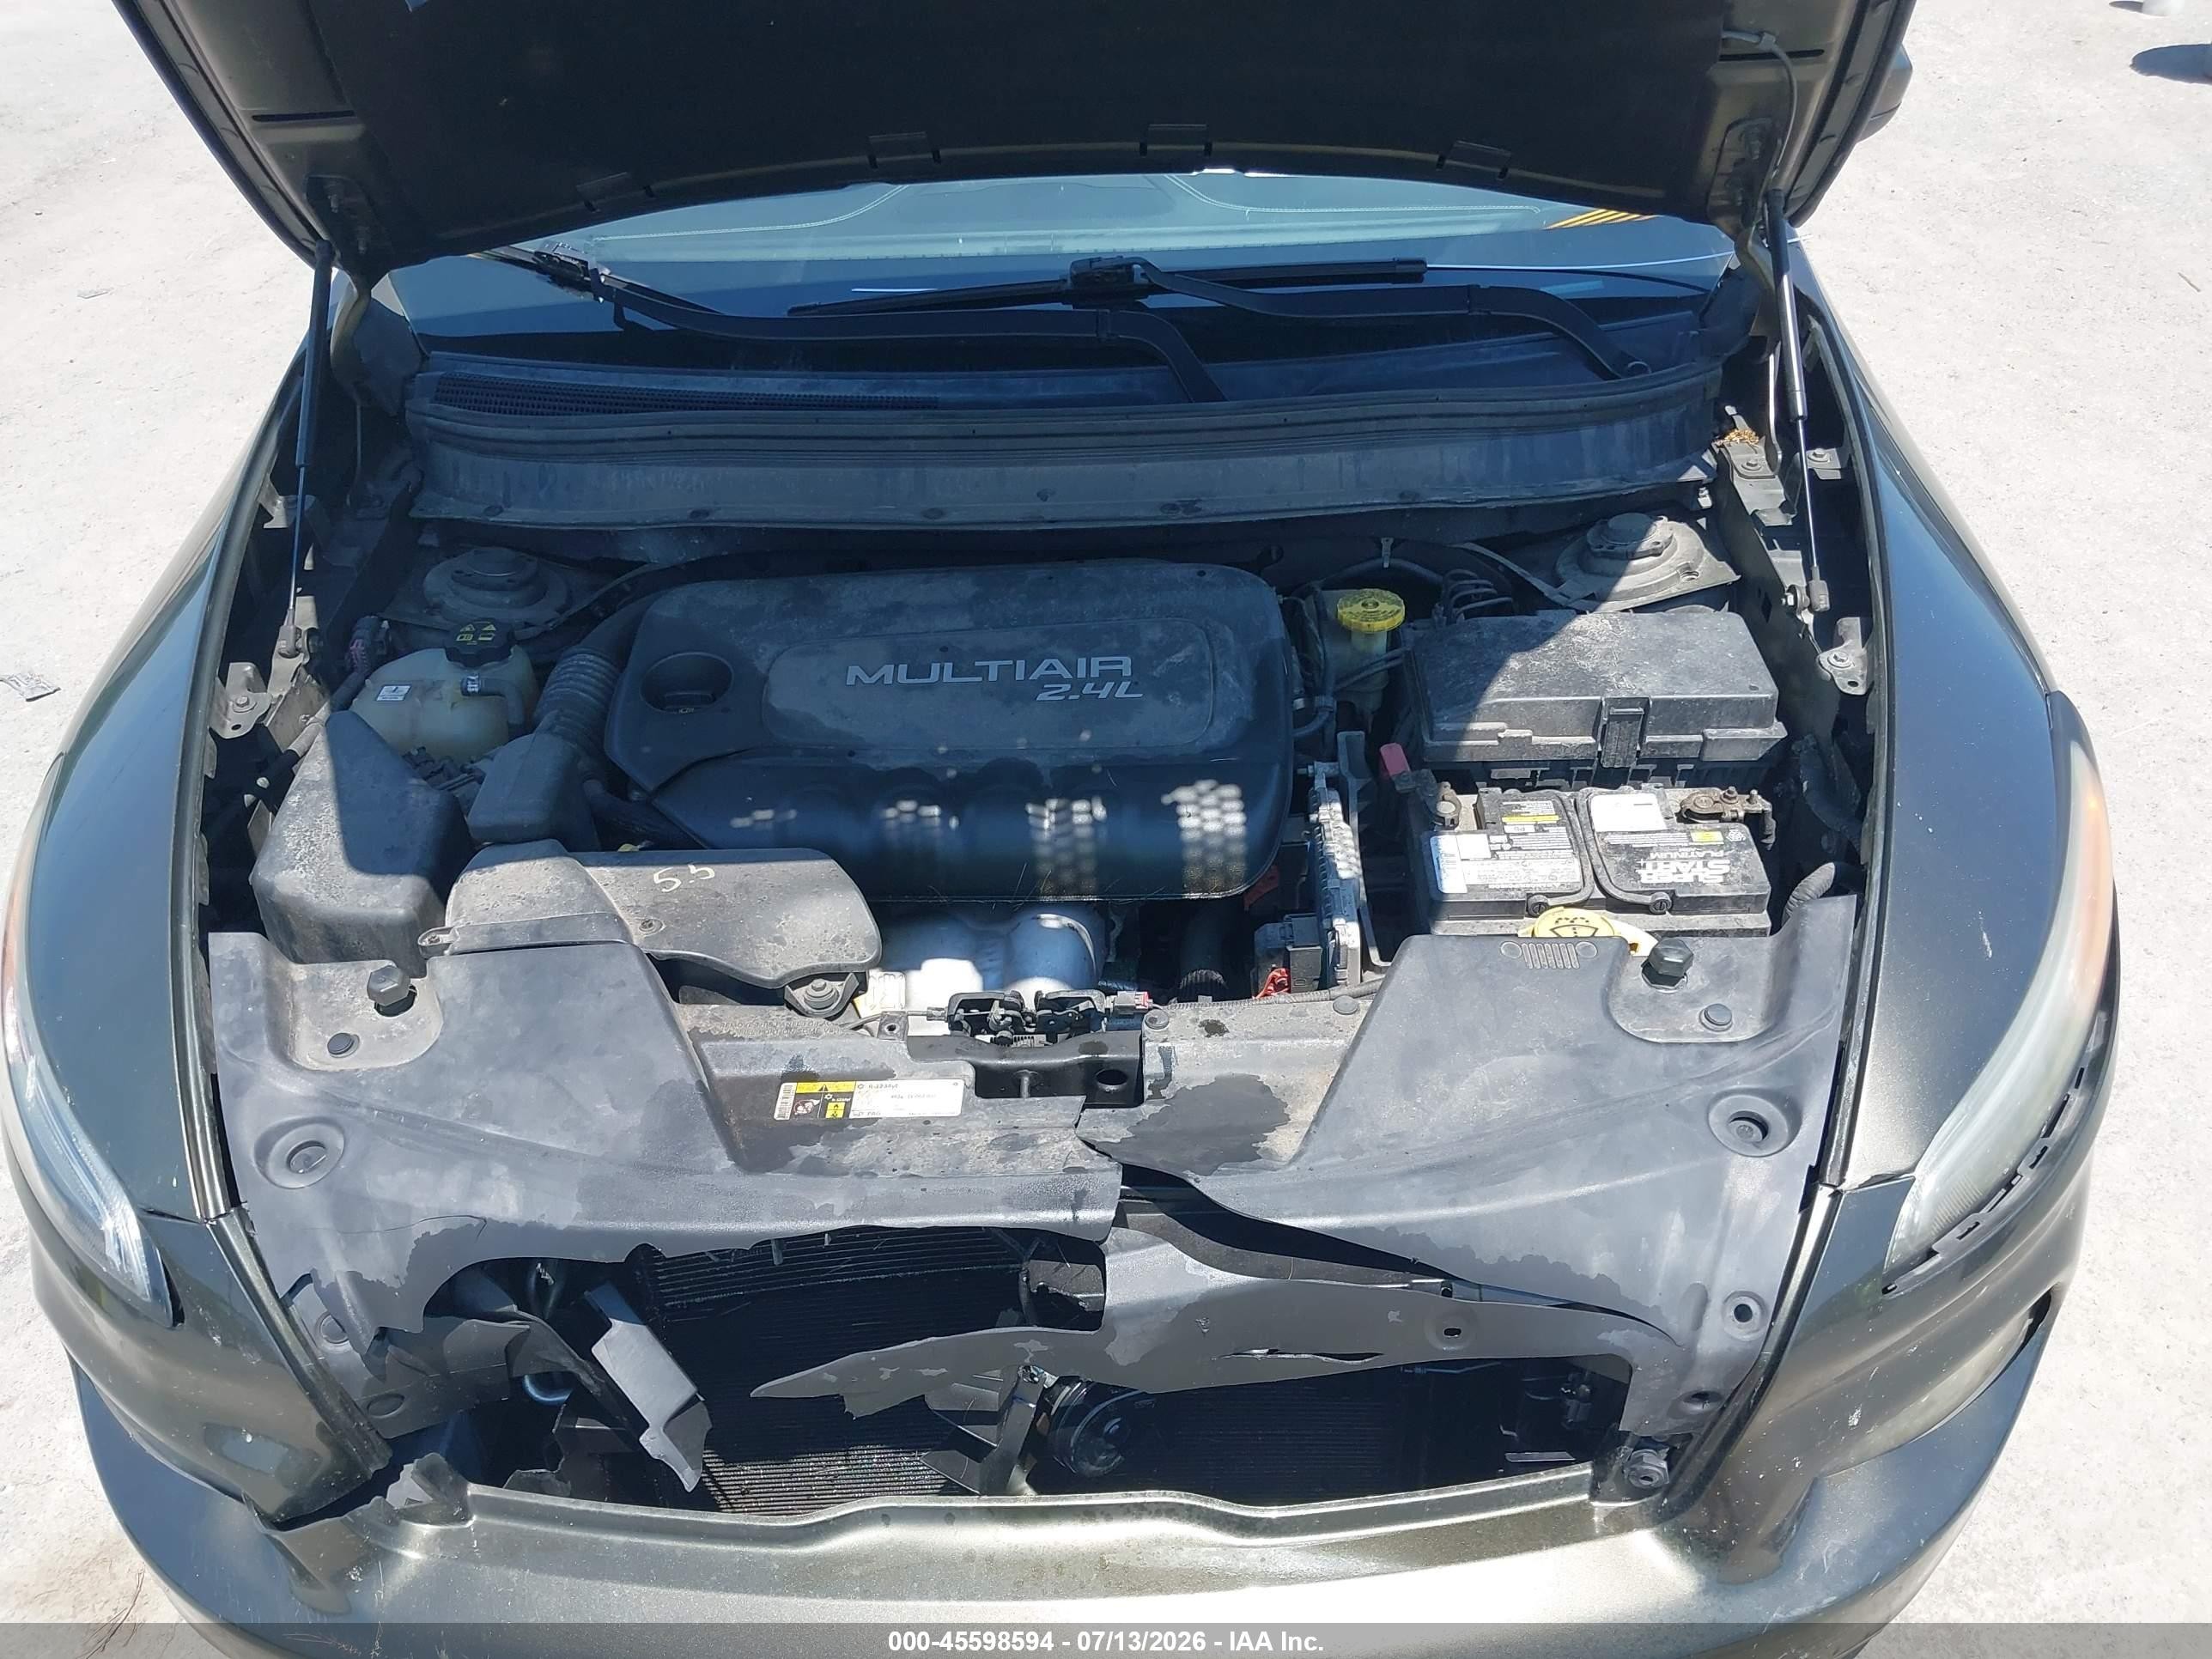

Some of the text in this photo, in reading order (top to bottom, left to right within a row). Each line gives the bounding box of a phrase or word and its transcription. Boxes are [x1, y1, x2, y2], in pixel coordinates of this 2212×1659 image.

[846, 656, 1132, 685] MULTIAIR
[1036, 681, 1143, 702] 2.4L
[1650, 850, 1725, 860] PLATINUM
[1642, 860, 1730, 874] START
[653, 864, 715, 892] 5.5
[1641, 873, 1724, 884] SUPER
